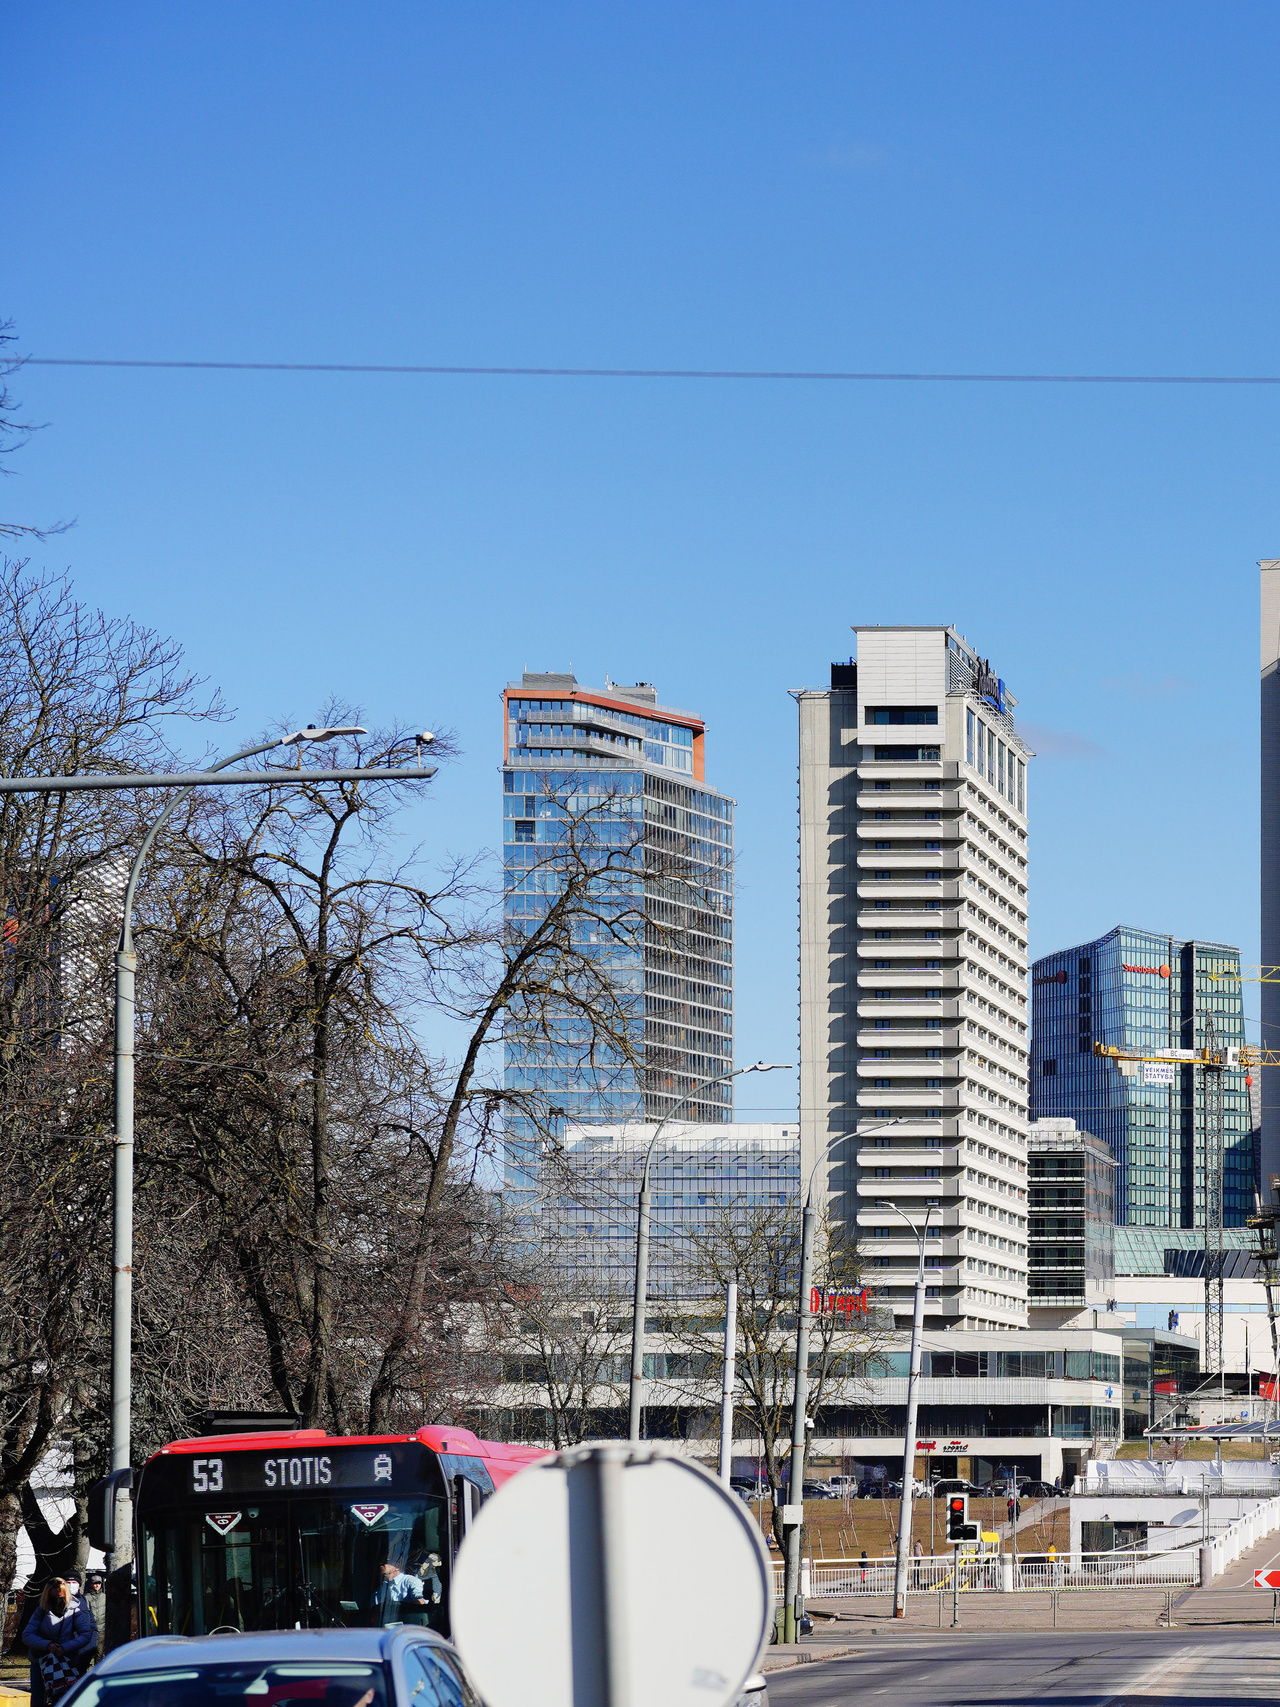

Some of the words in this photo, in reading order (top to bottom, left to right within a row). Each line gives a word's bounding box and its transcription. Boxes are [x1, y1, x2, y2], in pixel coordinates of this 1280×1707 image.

[1124, 963, 1159, 975] Swedbank
[193, 1459, 223, 1492] 53
[264, 1457, 332, 1487] STOTIS
